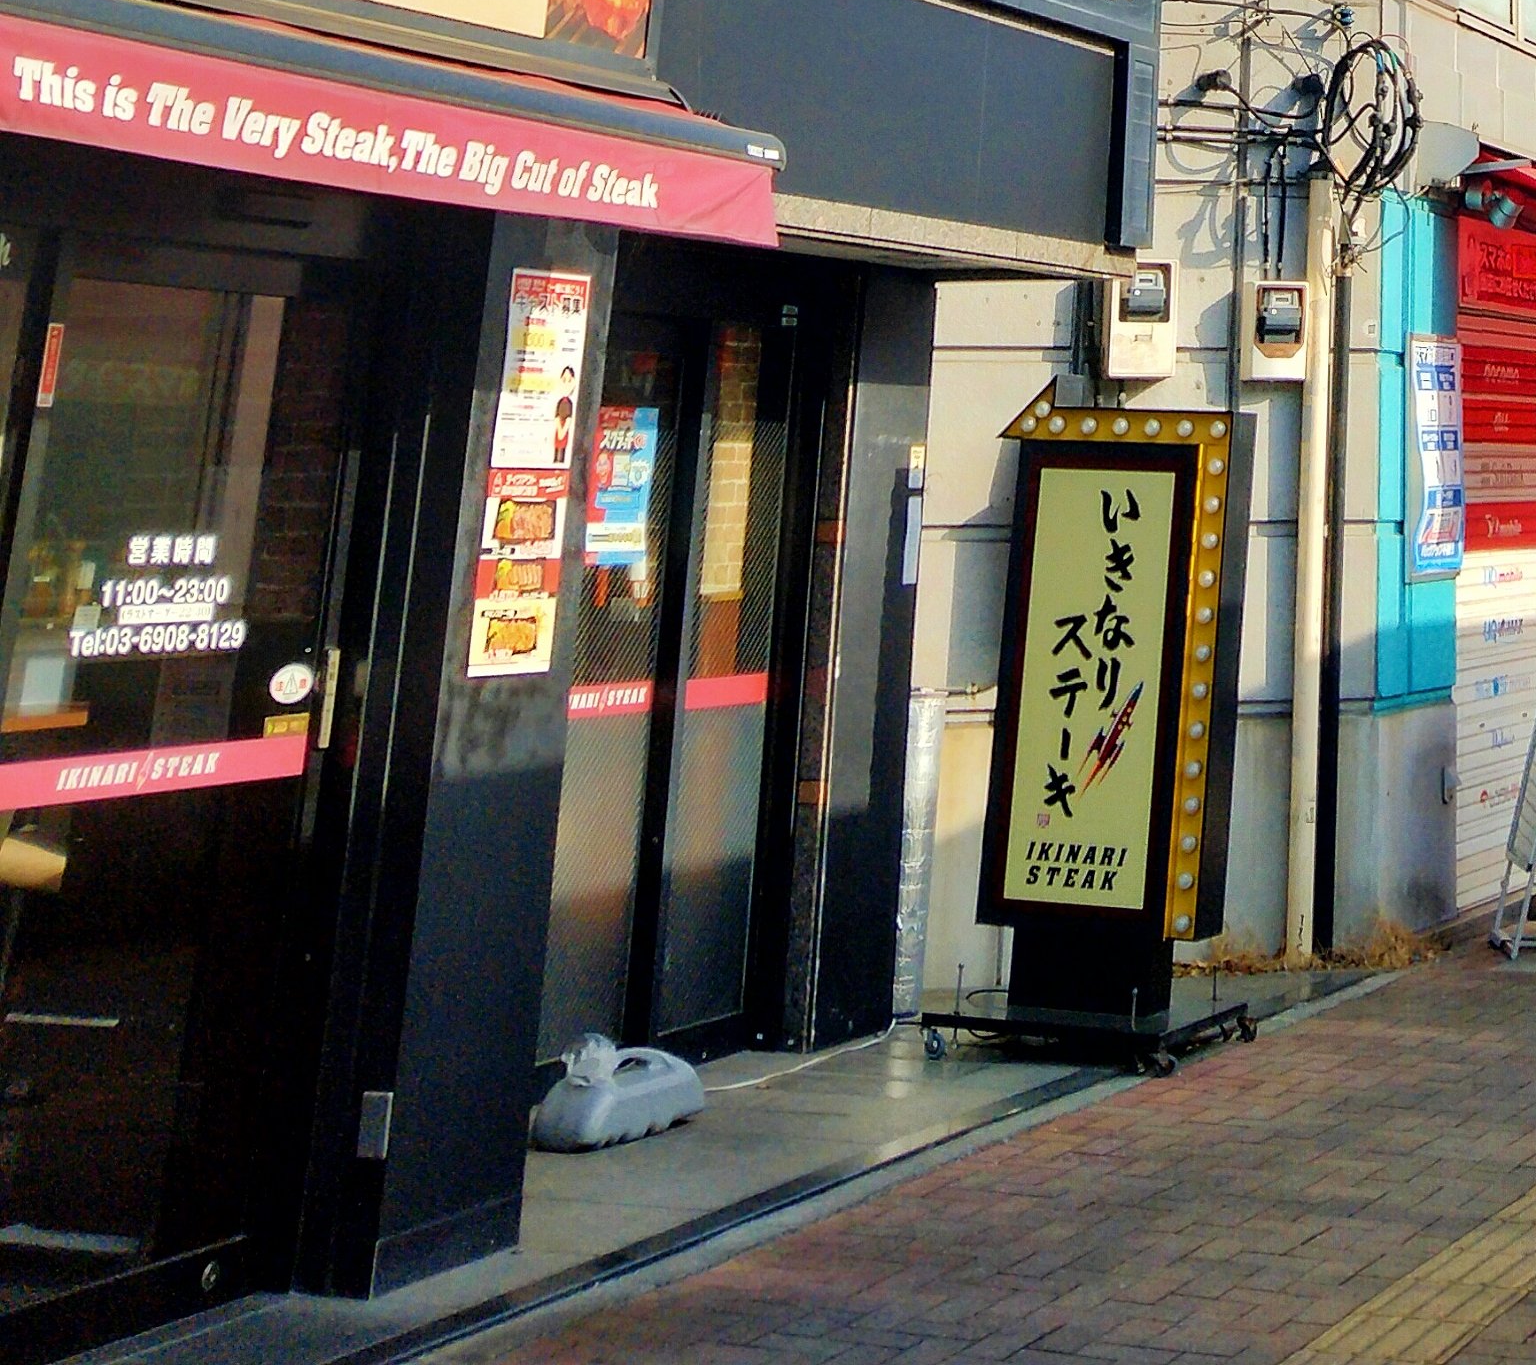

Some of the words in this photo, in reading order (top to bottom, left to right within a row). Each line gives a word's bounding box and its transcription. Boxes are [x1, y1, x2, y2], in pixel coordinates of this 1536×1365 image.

[13, 57, 97, 112] This
[102, 74, 136, 122] is
[146, 81, 215, 136] The
[222, 95, 302, 159] Very
[399, 129, 457, 177] The
[459, 141, 507, 196] Big
[510, 156, 557, 195] Cut
[557, 161, 590, 198] of
[589, 170, 660, 210] Steak
[127, 534, 217, 565] 営業時間
[1095, 488, 1141, 711] いきなり
[69, 620, 247, 657] Tel:03-6908-8129
[605, 686, 648, 708] STEAK
[1043, 614, 1092, 817] ステーキ
[56, 762, 137, 791] IKINARI
[150, 752, 220, 780] STEAK
[1025, 841, 1128, 867] IKINARI
[1025, 866, 1118, 891] STEAK
